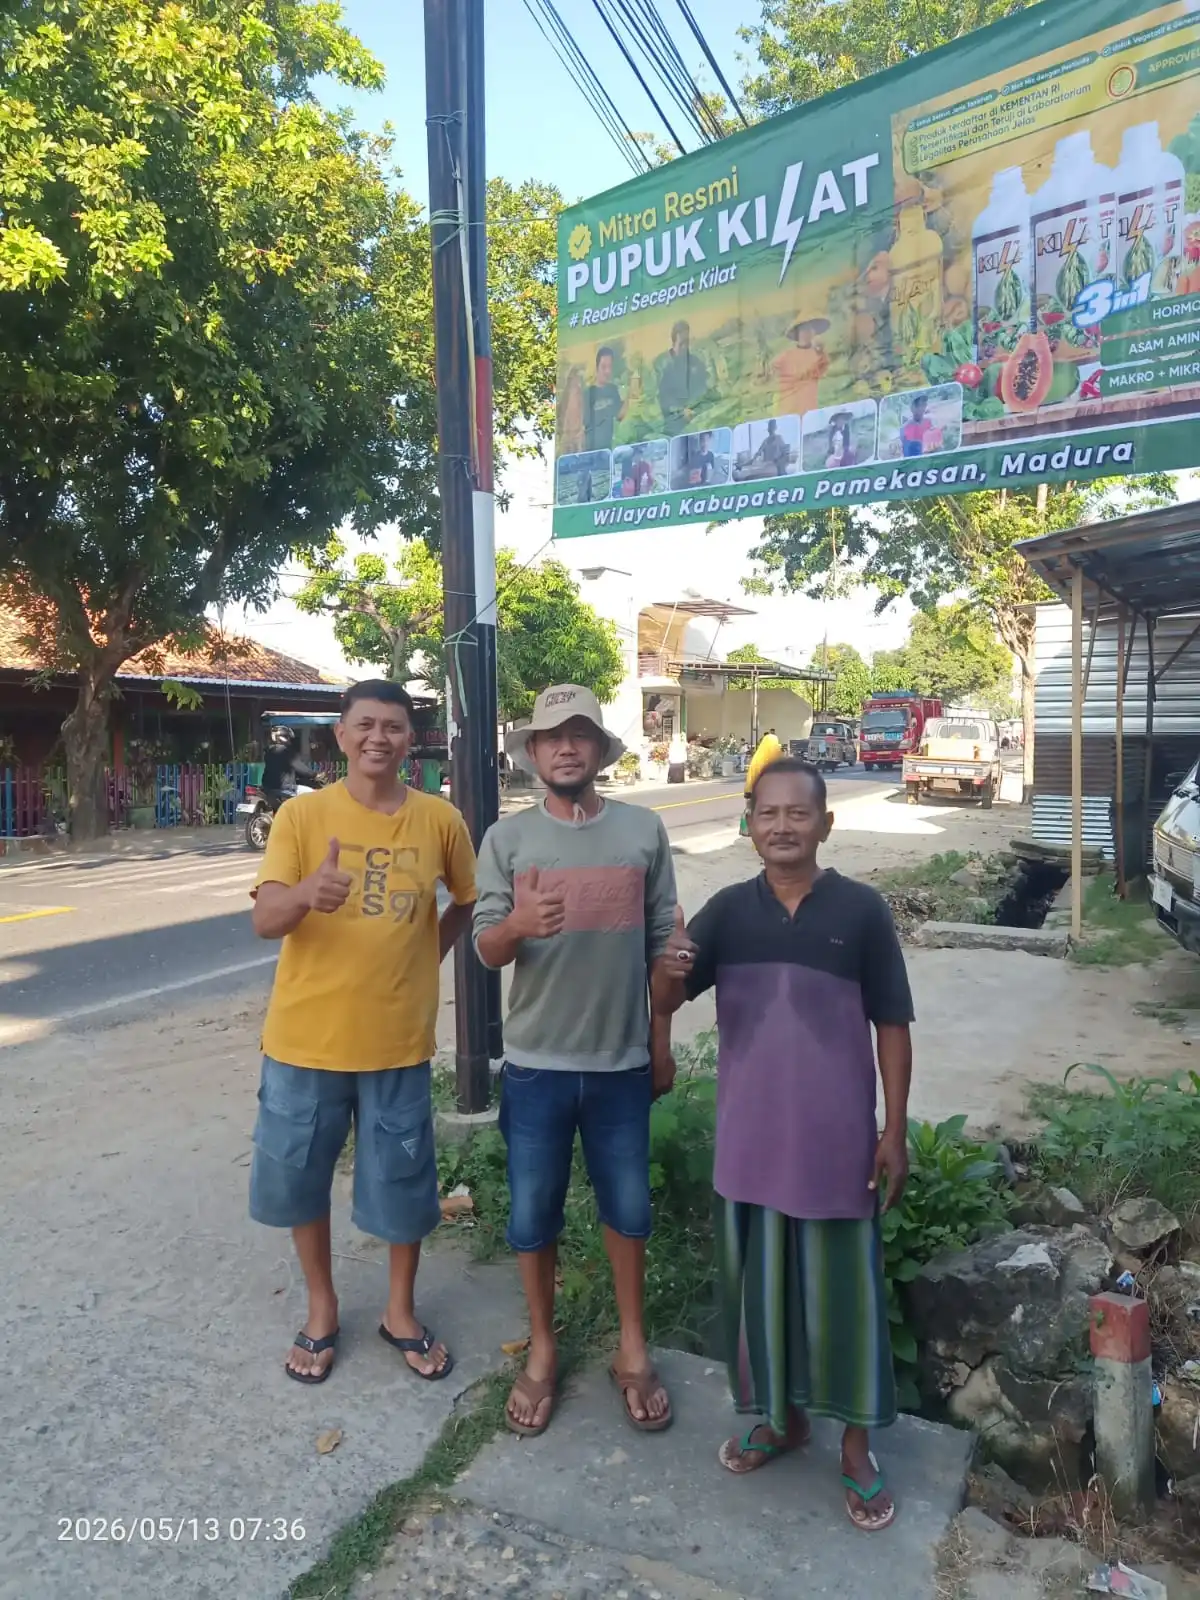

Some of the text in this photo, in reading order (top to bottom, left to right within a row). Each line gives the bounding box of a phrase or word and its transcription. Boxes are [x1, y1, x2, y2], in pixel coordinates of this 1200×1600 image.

[972, 123, 989, 134] dan
[1027, 84, 1091, 114] Laboratorium
[1000, 89, 1048, 112] KEMENTAN
[1051, 82, 1061, 94] RI
[920, 116, 1036, 163] Legalitas Perusahaan Jelas
[567, 153, 879, 303] PUPUK KILAT
[599, 166, 739, 246] Mitra Resmi
[582, 301, 627, 326] Reaksi
[631, 284, 694, 314] Secepat
[699, 262, 737, 291] Kilat
[1129, 338, 1164, 355] ASAM
[1109, 370, 1155, 388] MAKRO
[593, 441, 1133, 526] Wilayah Kabupaten Pamekasan, Madura
